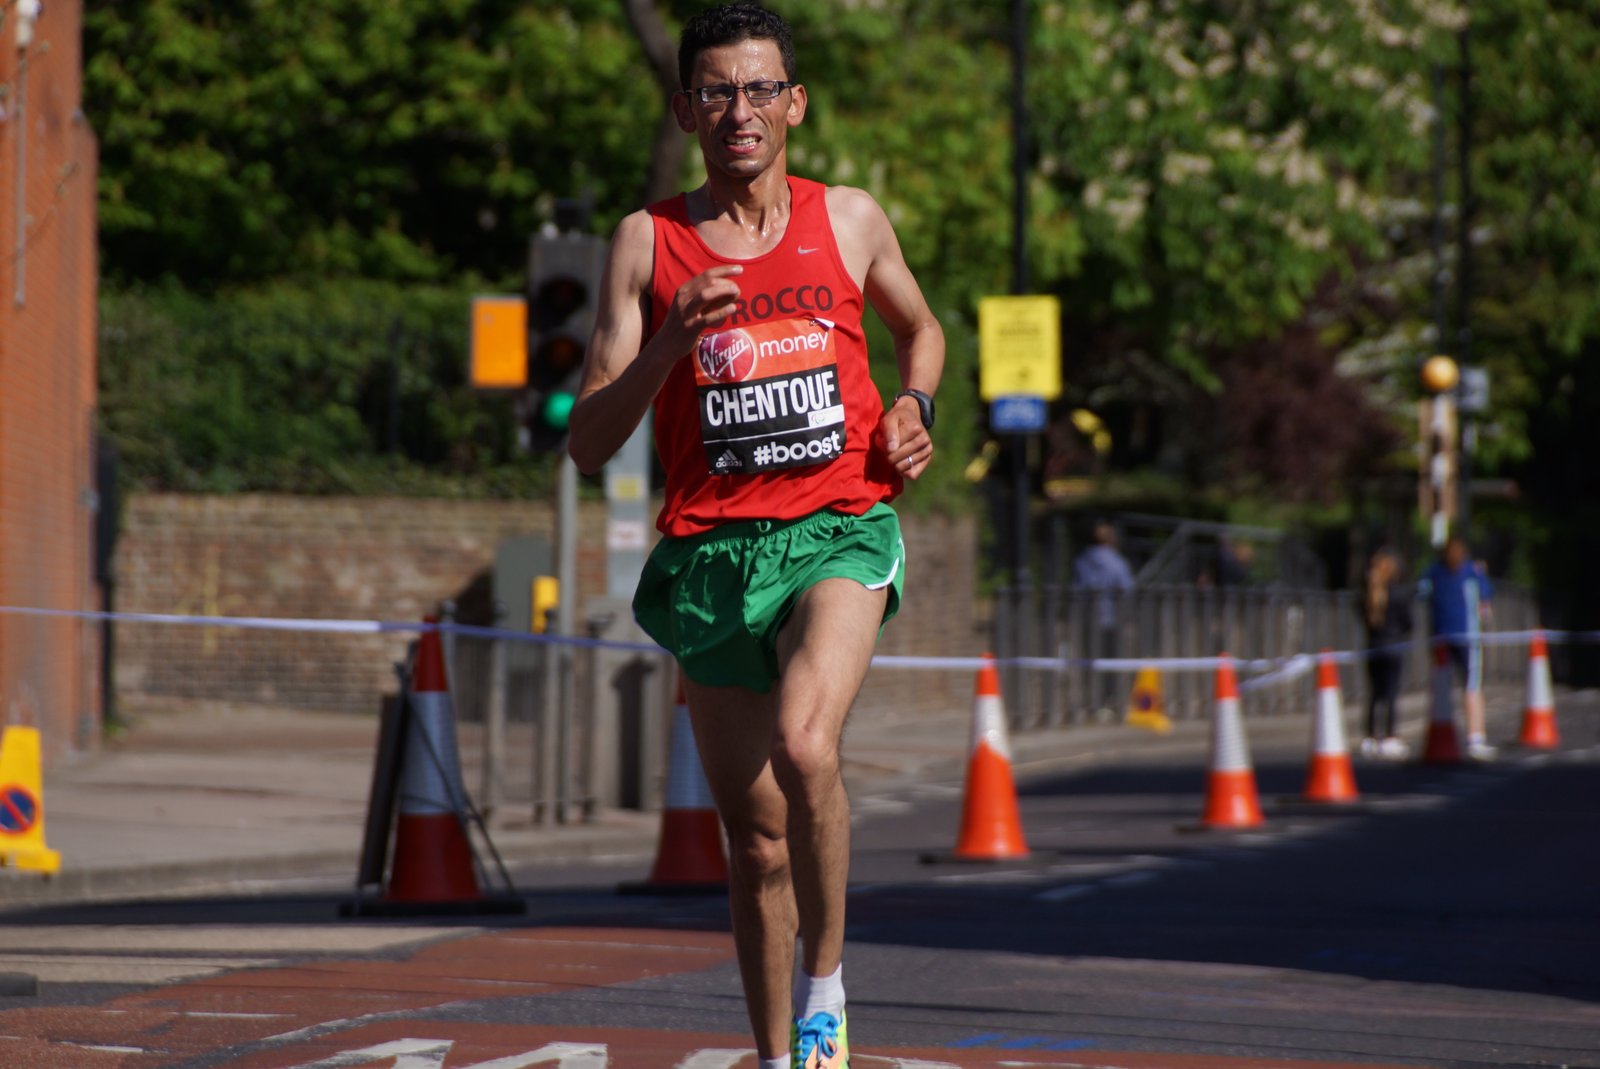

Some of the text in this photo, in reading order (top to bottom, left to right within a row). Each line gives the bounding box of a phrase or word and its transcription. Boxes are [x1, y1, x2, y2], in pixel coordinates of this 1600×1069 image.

[702, 332, 828, 377] Virgin money
[706, 371, 835, 426] CHENTOUF
[754, 430, 841, 466] #boost
